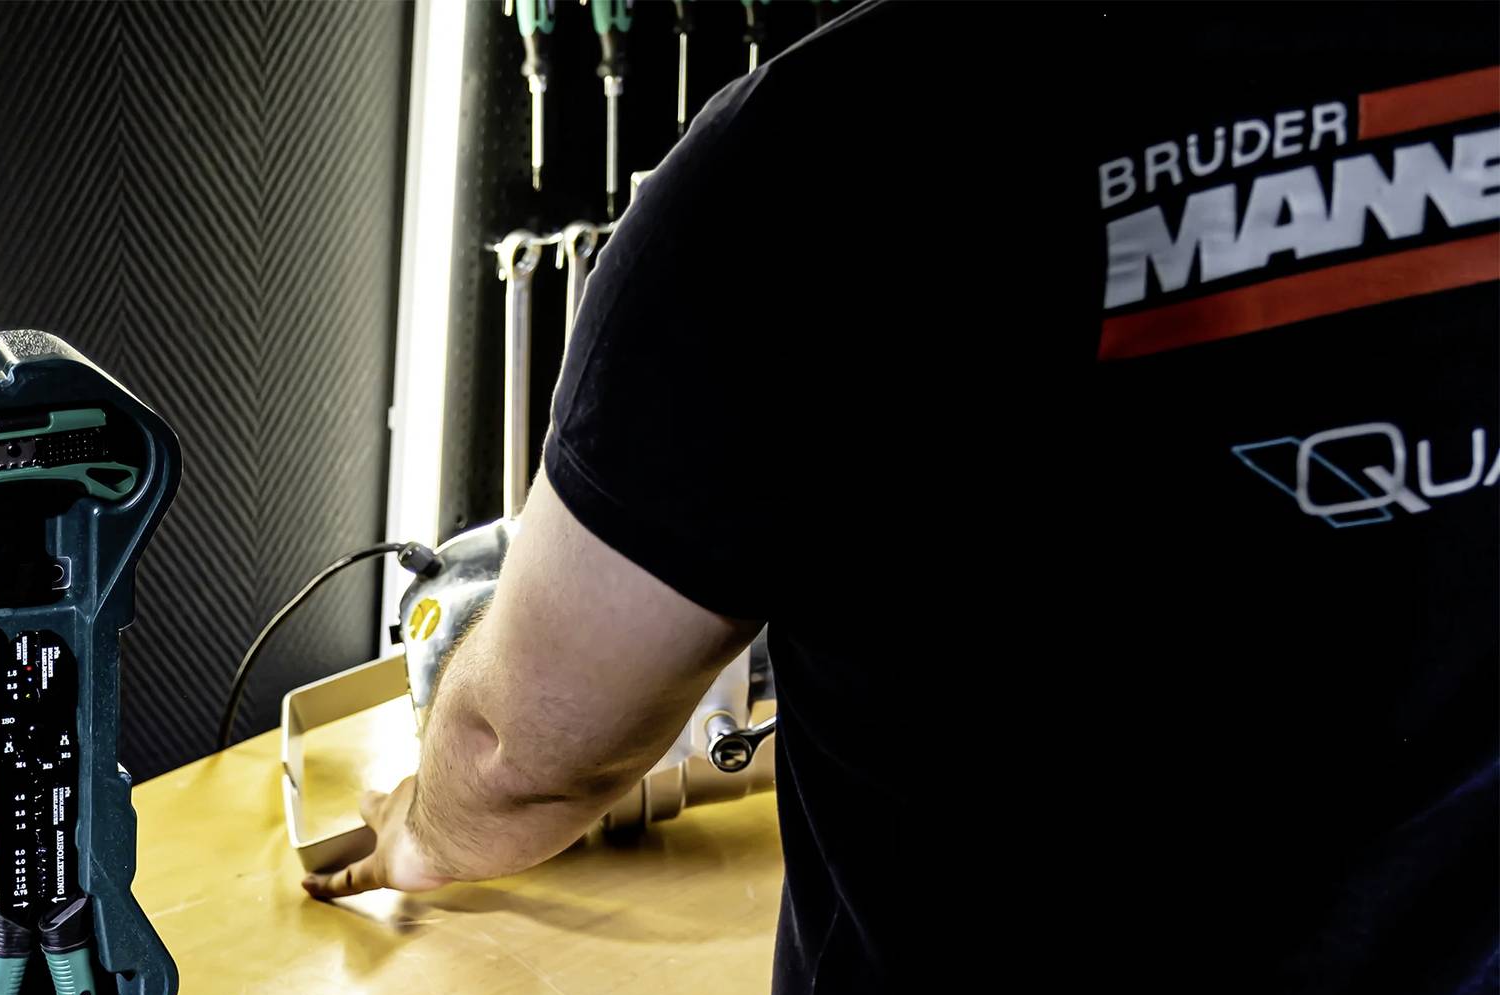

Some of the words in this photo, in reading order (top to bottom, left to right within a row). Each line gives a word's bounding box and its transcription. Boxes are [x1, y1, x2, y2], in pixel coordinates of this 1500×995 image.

[1099, 101, 1347, 208] BRÜDER
[1297, 422, 1500, 514] QU
[56, 830, 65, 895] ABISOLIERUNG
